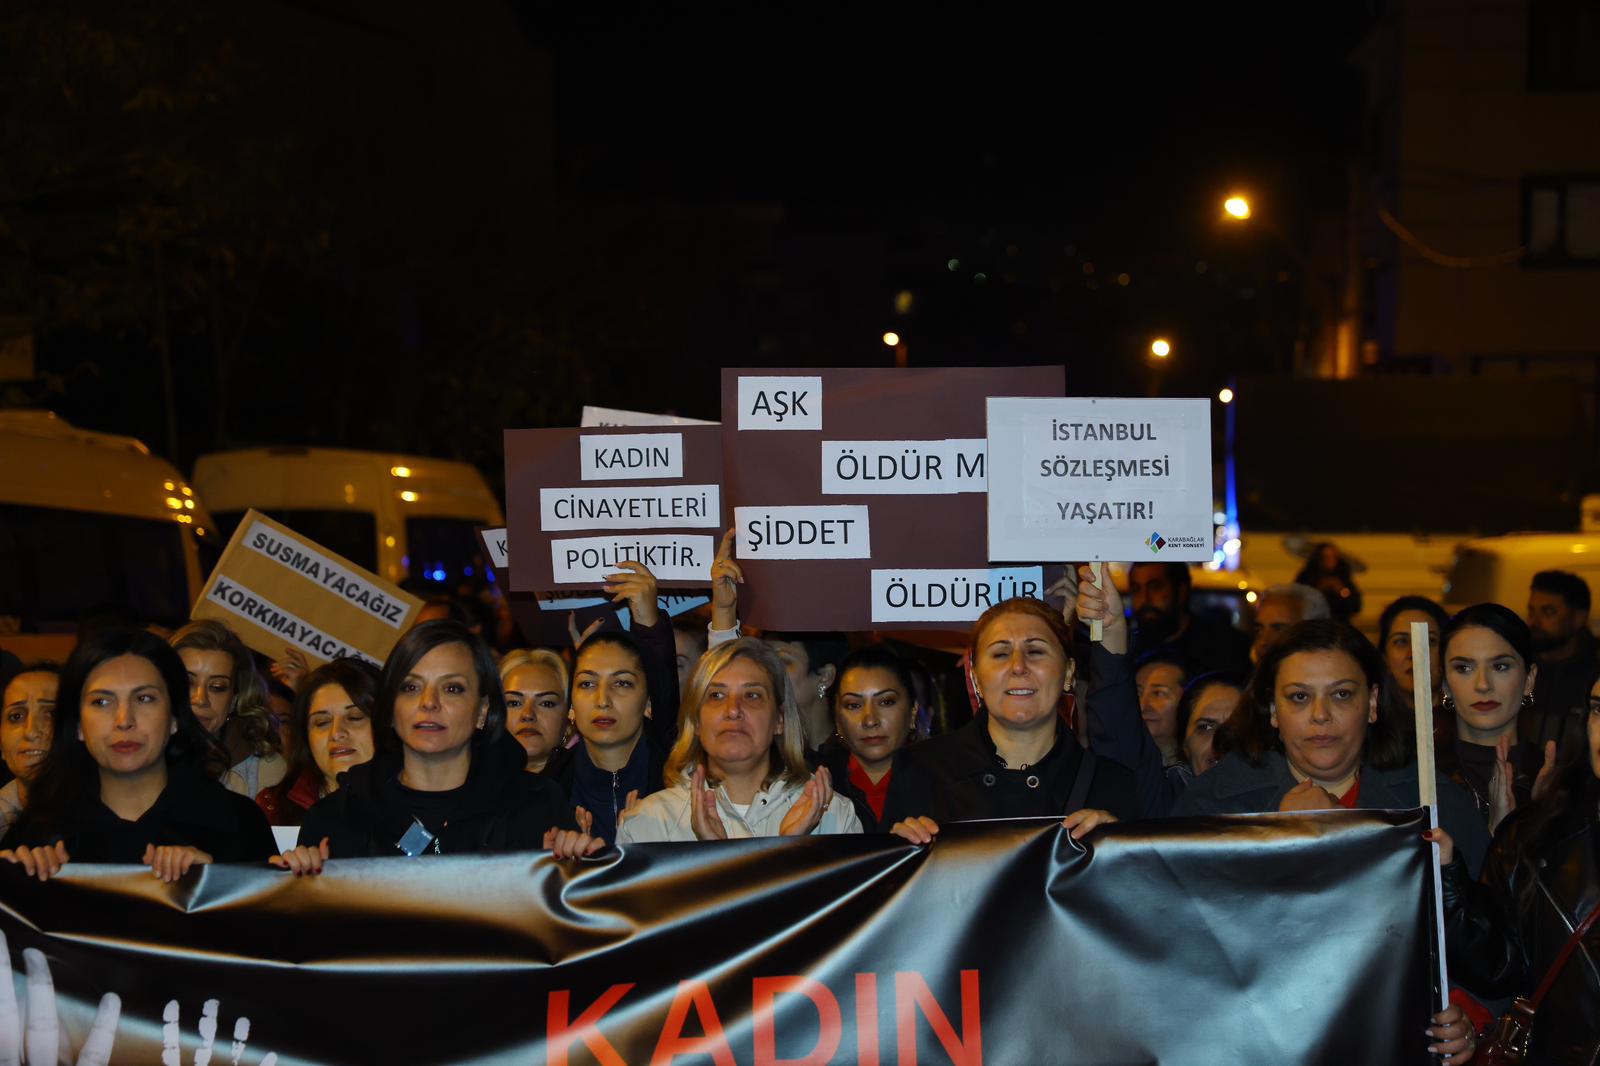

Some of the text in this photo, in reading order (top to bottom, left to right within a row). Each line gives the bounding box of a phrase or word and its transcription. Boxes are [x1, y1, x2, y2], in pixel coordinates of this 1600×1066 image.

[751, 390, 809, 422] AŞK
[1052, 418, 1157, 441] İSTANBUL
[595, 447, 669, 469] KADIN
[836, 449, 943, 480] ÖLDÜR
[1040, 454, 1170, 481] SÖZLEŞMESİ
[553, 492, 707, 519] CİNAYETLERİ
[1056, 501, 1154, 525] YAŞATIR!
[747, 514, 855, 551] ŞİDDET
[566, 541, 701, 571] POLİTİKTİR.
[252, 531, 404, 623] SUSMAYACAĞIZ
[885, 576, 1038, 608] ÖLDÜRÜR
[212, 581, 380, 668] KORKMAYACA
[546, 968, 983, 1066] KADIN
